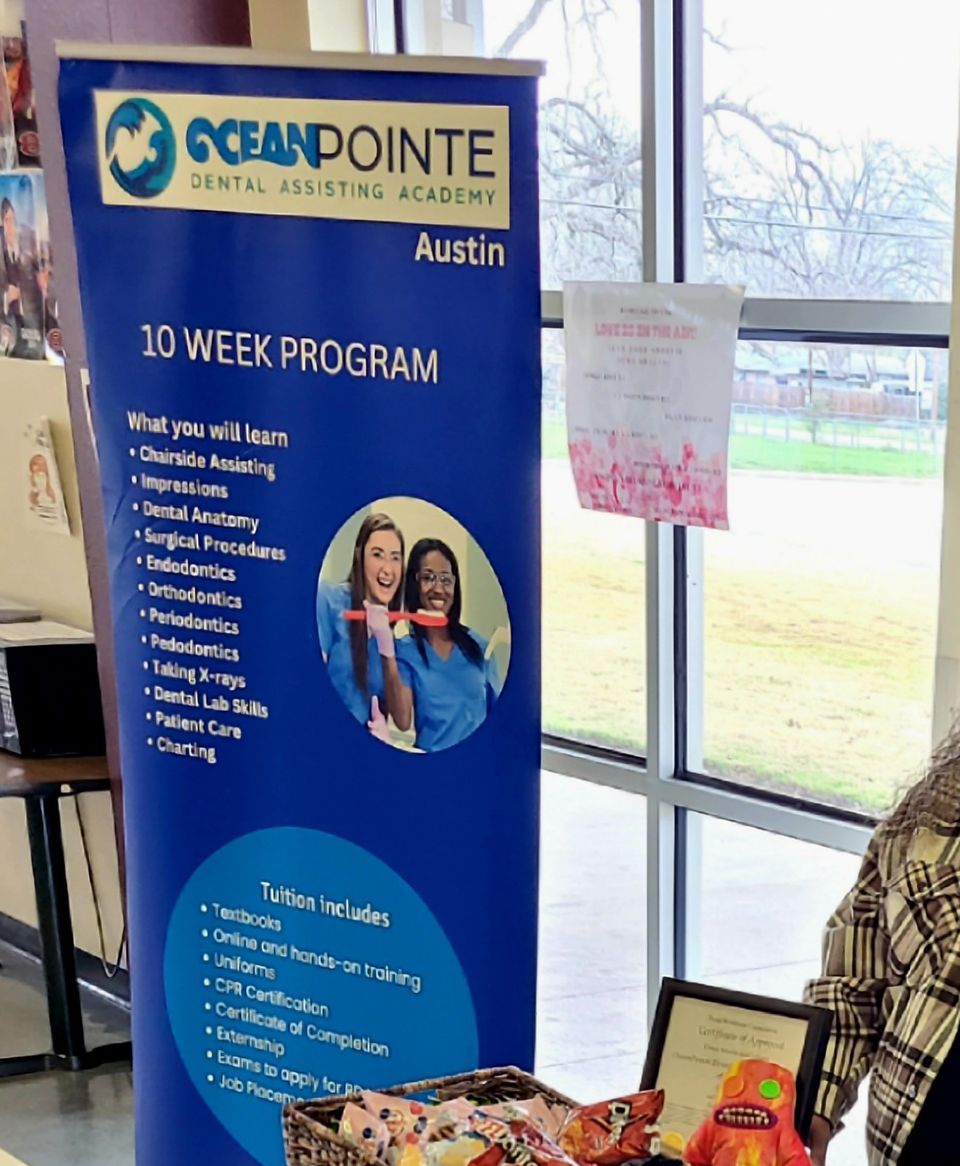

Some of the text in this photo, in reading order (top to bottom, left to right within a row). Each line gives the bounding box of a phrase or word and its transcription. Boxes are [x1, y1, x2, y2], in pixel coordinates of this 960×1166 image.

[186, 117, 495, 178] OCEANPOINTE
[191, 172, 496, 206] DENTAL ASSISTING ACADEMY
[414, 231, 506, 267] Austin
[140, 324, 439, 384] 10 WEEK PROGRAM
[127, 410, 289, 448] What you will learn
[140, 446, 277, 482] Chairside Assisting
[141, 473, 229, 499] Impressions
[143, 501, 260, 535] Dental Anatomy
[144, 527, 287, 562] Surgical Procedures
[146, 554, 237, 582] Endodontics
[148, 581, 243, 610] Orthodontics
[149, 607, 240, 636] Periodontics
[151, 633, 240, 662] Pedodontics
[152, 659, 247, 691] Taking X-rays
[154, 686, 269, 719] Dental Lab Skills
[155, 710, 242, 740] Patient Care
[157, 736, 217, 764] Charting
[212, 902, 282, 932] Textbooks
[260, 881, 391, 928] Tuition includes
[213, 927, 422, 994] Online and hands-on training
[214, 952, 277, 981] Uniforms
[215, 977, 330, 1018] CPR Certification
[215, 1001, 390, 1058] Certificate of Completion
[216, 1025, 286, 1059] Externship
[217, 1049, 262, 1074] Exams
[264, 1062, 279, 1079] to
[281, 1068, 320, 1092] apply
[323, 1075, 342, 1095] for
[218, 1073, 245, 1094] Job
